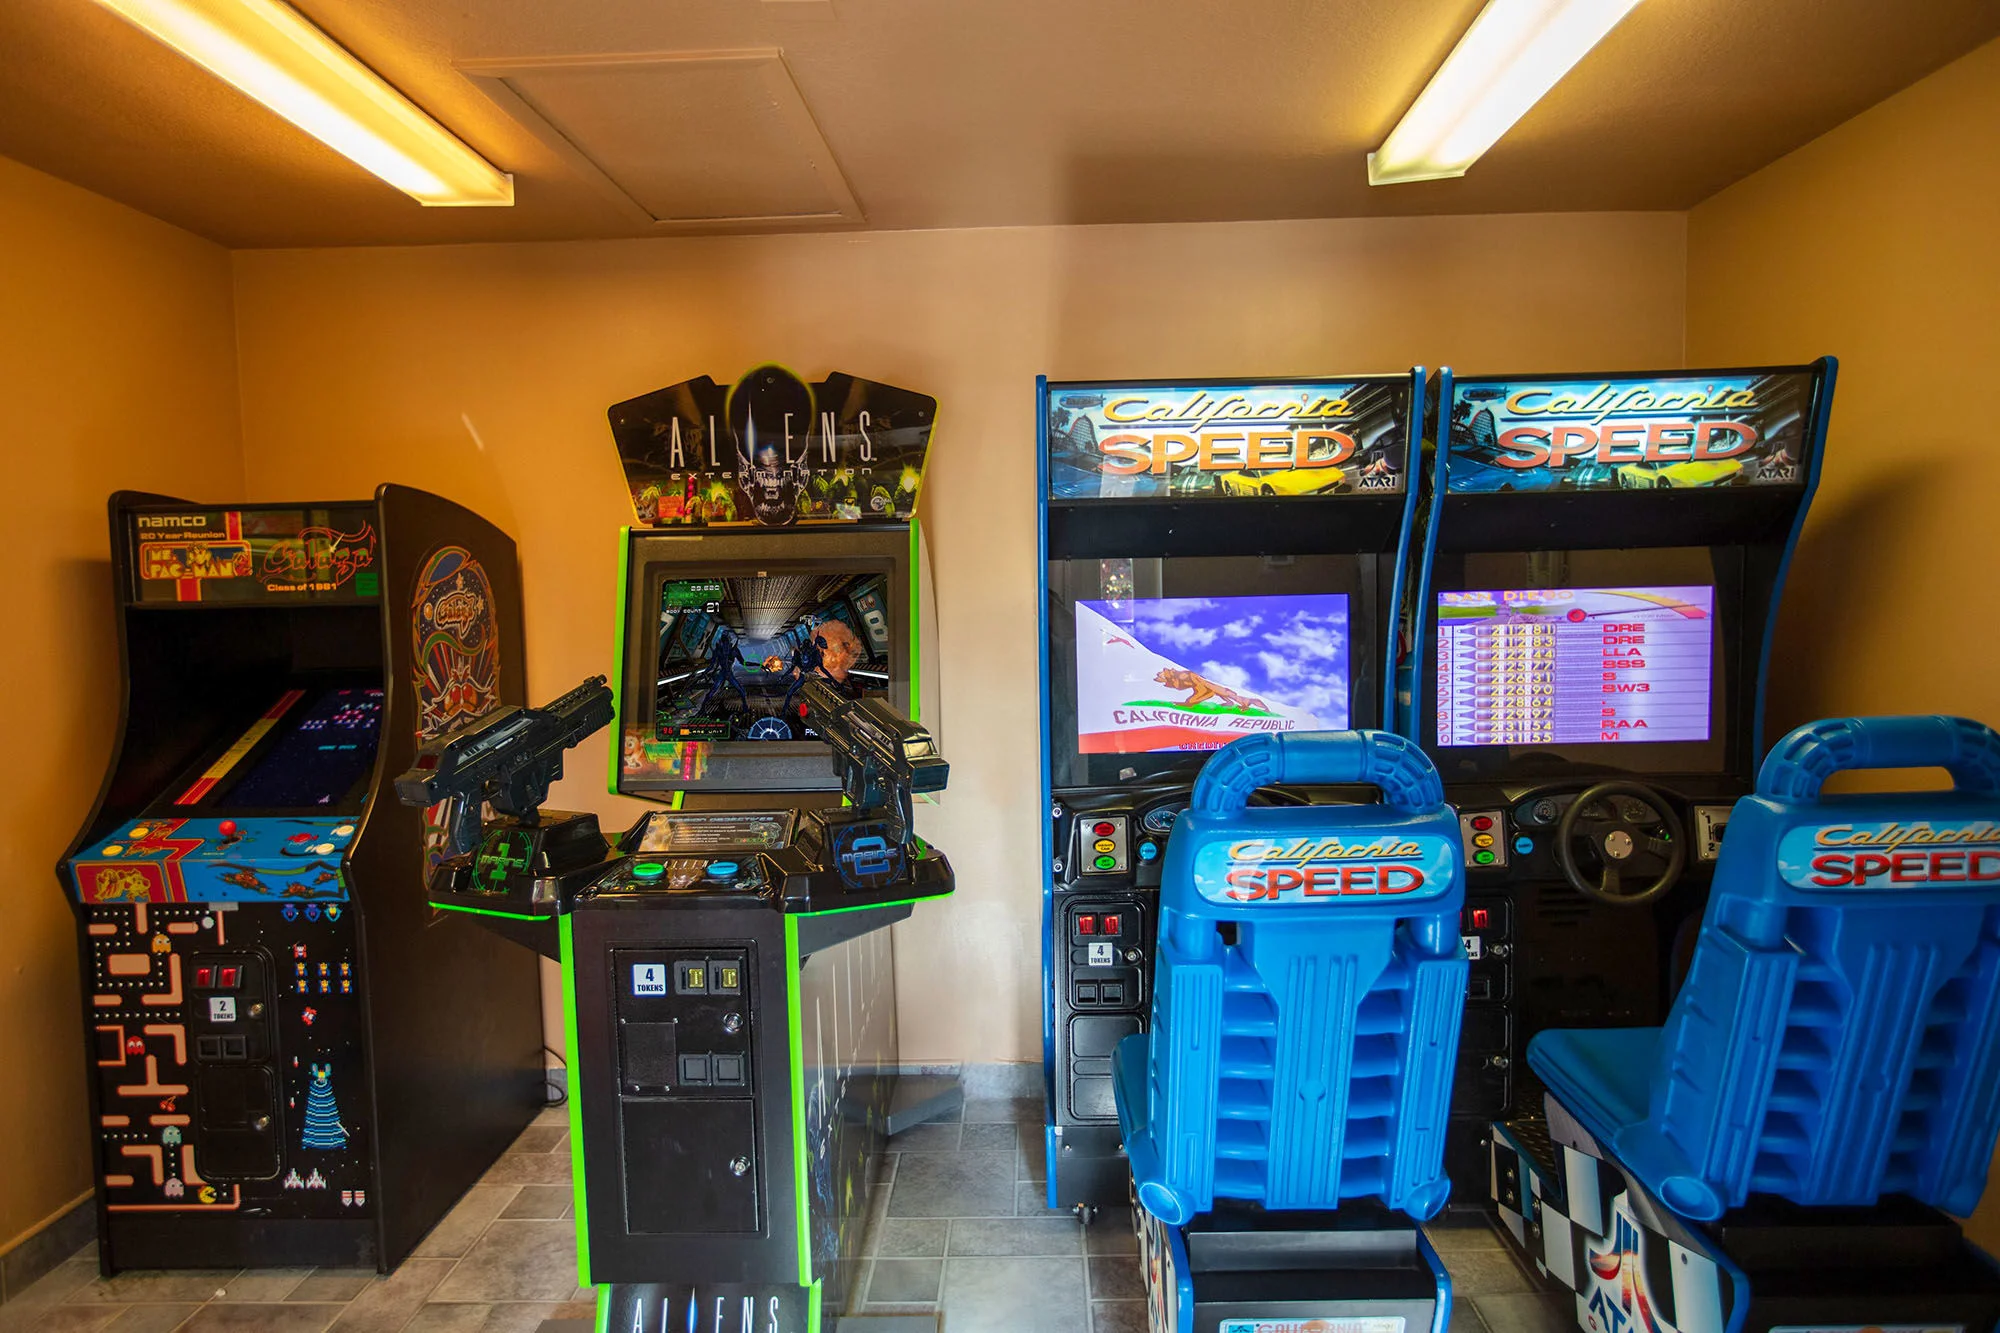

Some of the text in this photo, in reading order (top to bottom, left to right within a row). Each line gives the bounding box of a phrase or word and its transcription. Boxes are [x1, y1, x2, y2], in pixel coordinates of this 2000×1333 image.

[1506, 382, 1759, 425] California
[1104, 391, 1354, 432] California
[670, 409, 873, 468] ALIENS
[1494, 422, 1759, 469] SPEED
[1098, 430, 1356, 476] SPEED
[1757, 467, 1795, 480] ATARI
[1359, 477, 1396, 488] ATARI
[138, 515, 207, 528] namco
[156, 532, 182, 540] Year
[184, 531, 226, 539] Reunion
[263, 538, 376, 587] Galaga
[267, 583, 337, 592] Class of 1981
[1445, 590, 1575, 602] SAN DIEGO
[706, 602, 720, 613] 21
[1602, 623, 1645, 633] DRE
[1602, 635, 1645, 645] DRE
[1602, 647, 1642, 657] LLA
[1113, 710, 1295, 731] CALIFORNIA REPUBLIC
[1601, 719, 1648, 729] RAA
[1601, 731, 1619, 741] M
[1229, 838, 1423, 868] California
[1226, 865, 1425, 900] SPEED
[1464, 939, 1472, 950] 4
[1097, 945, 1104, 956] 4
[645, 968, 655, 982] 4
[637, 984, 664, 992] TOKENS
[219, 1001, 227, 1011] 2
